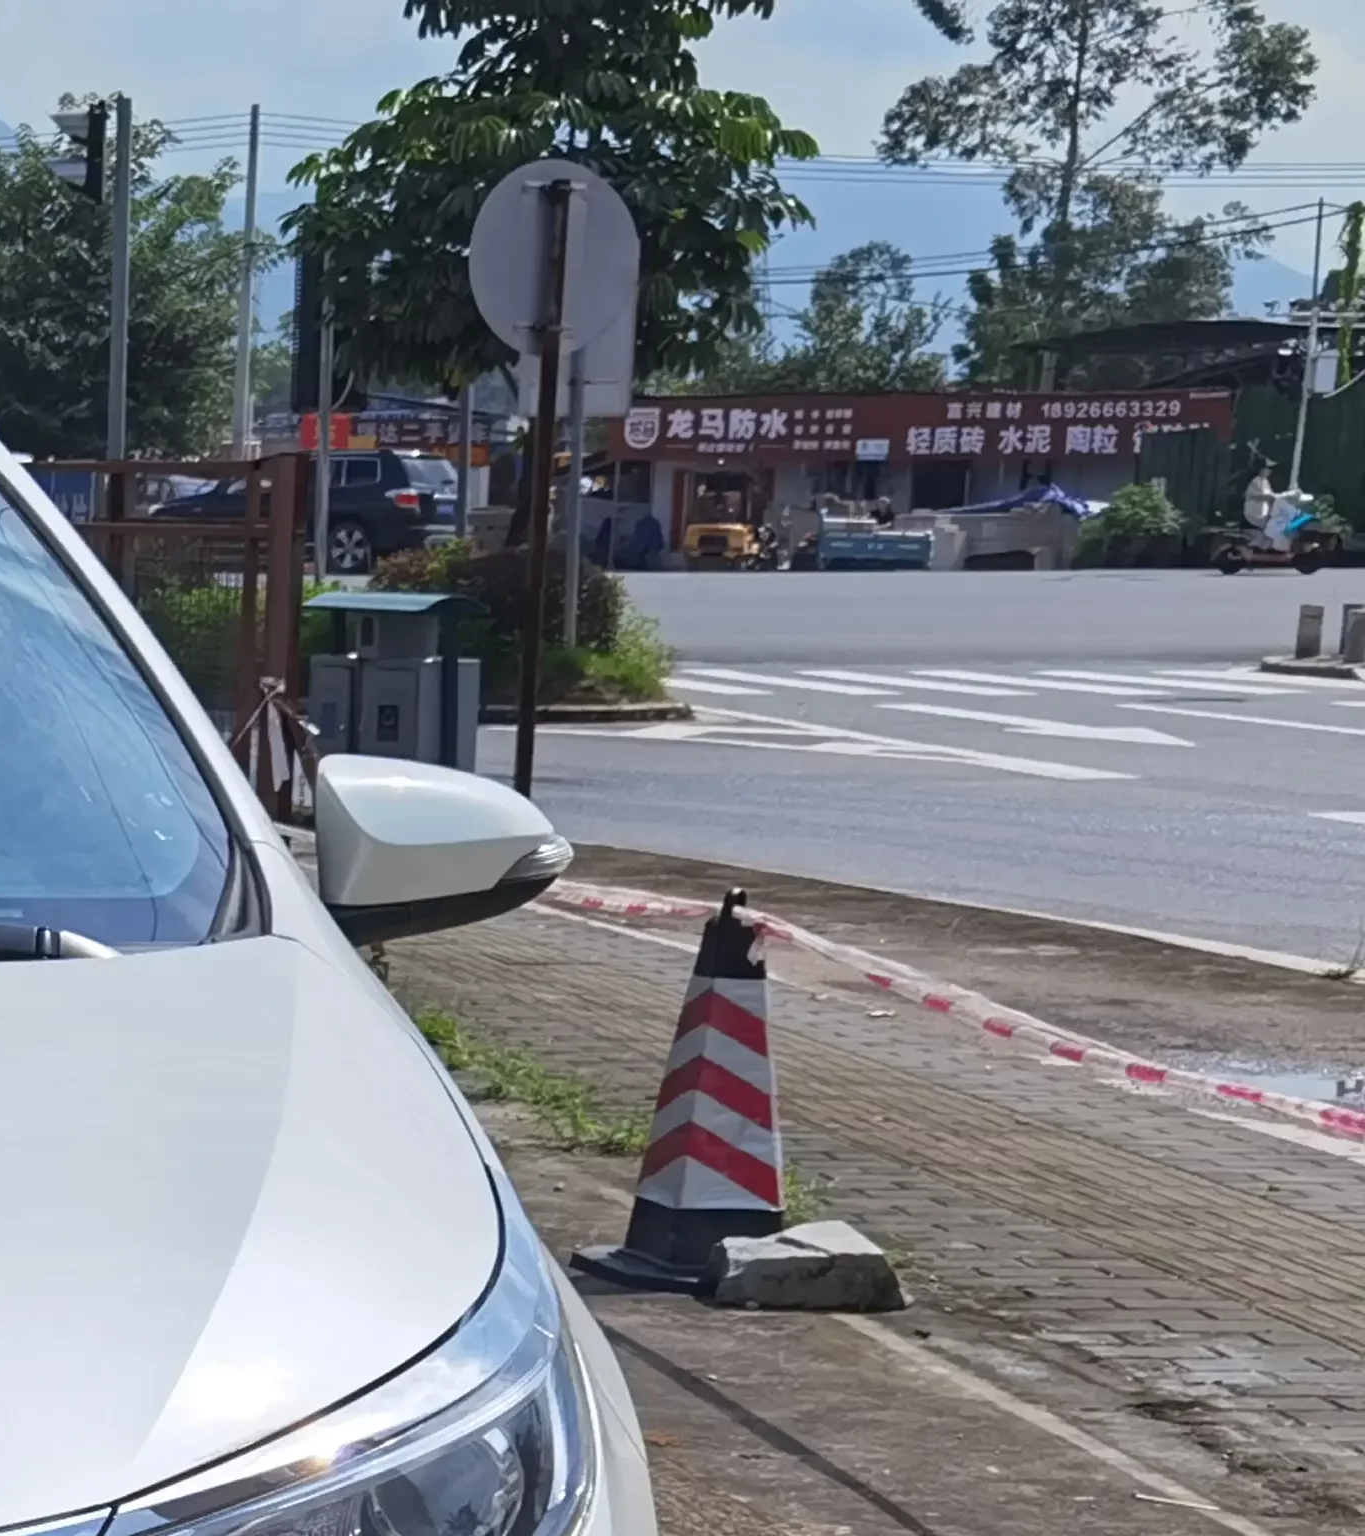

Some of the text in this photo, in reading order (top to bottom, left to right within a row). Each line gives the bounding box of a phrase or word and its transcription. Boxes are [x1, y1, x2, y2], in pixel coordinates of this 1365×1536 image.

[666, 408, 788, 439] 龙马防水
[906, 426, 986, 455] 轻质砖
[998, 425, 1051, 455] 水泥
[1065, 425, 1118, 455] 陶粒
